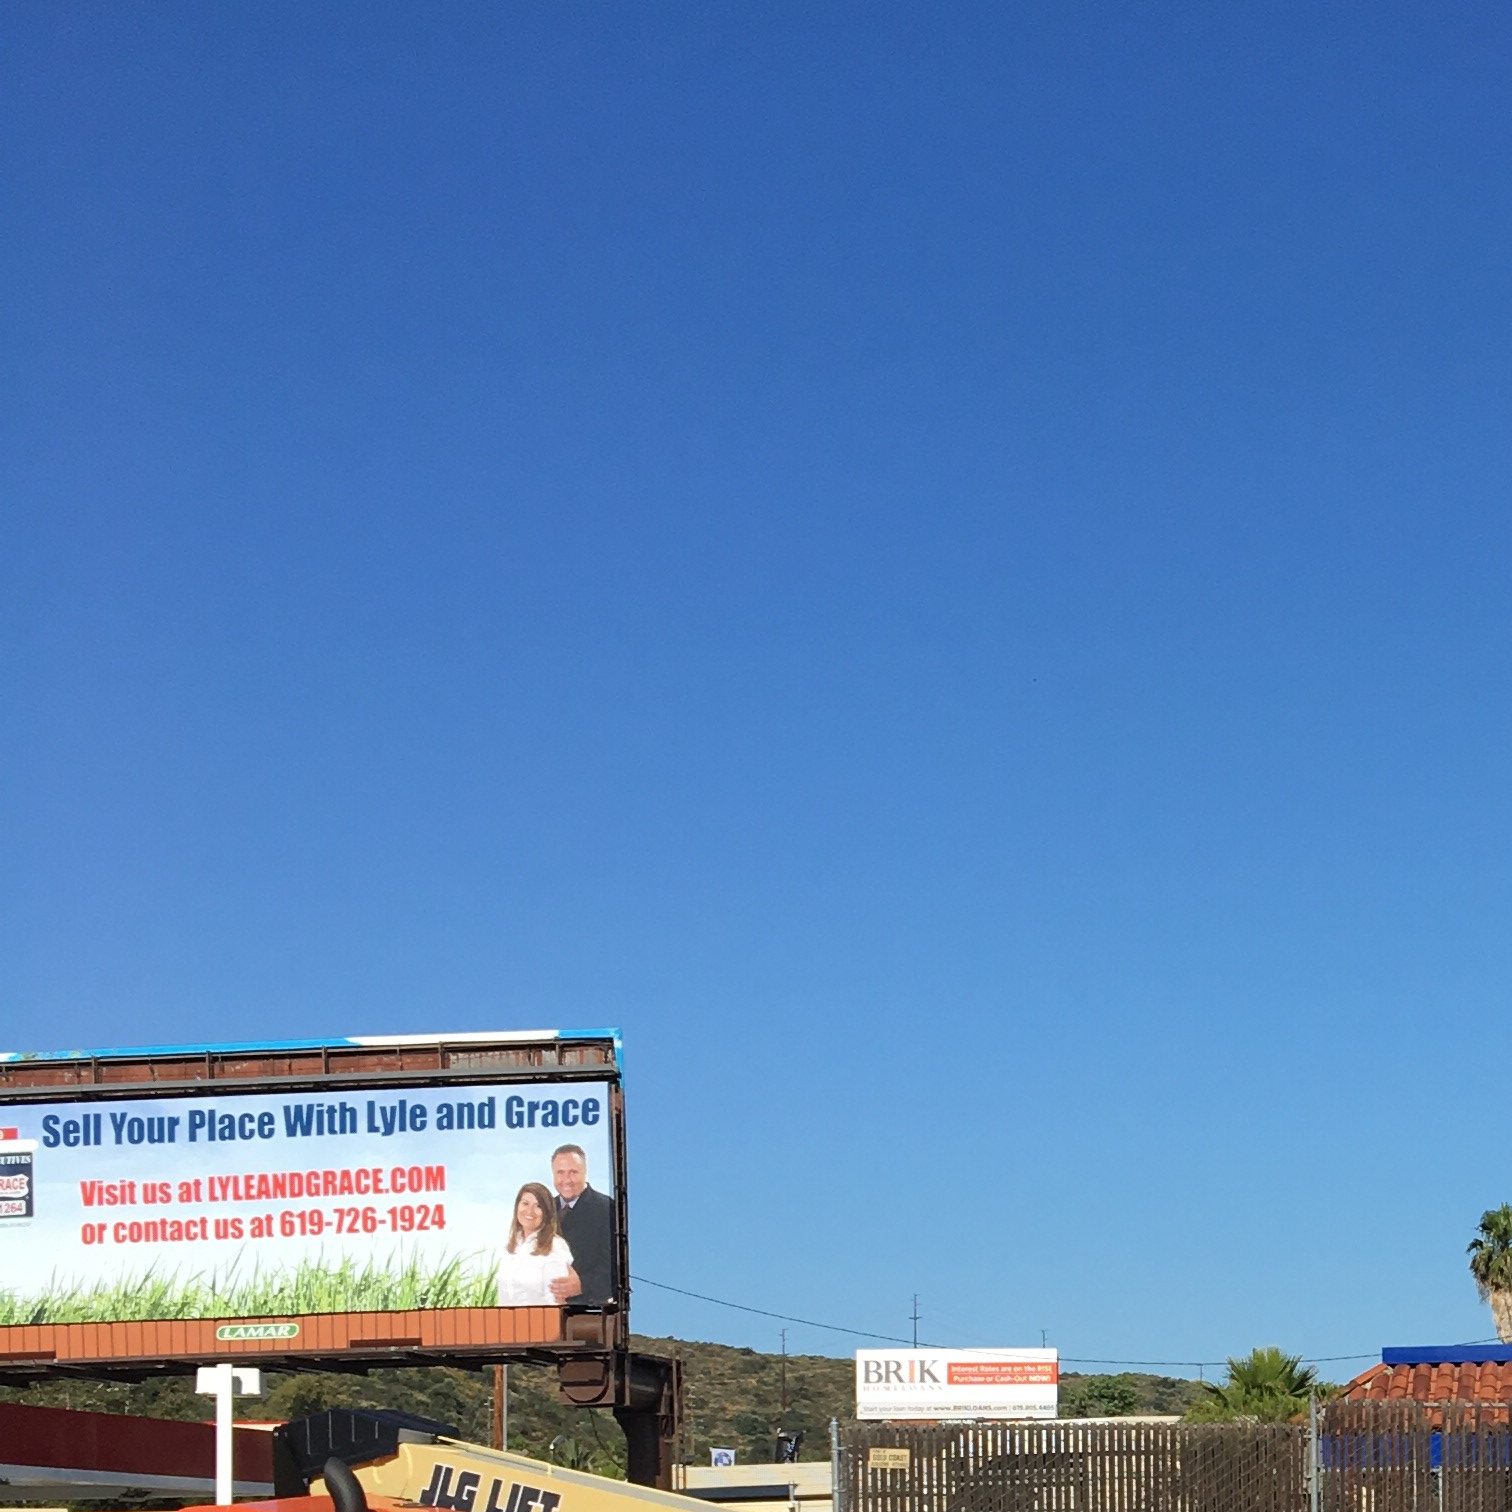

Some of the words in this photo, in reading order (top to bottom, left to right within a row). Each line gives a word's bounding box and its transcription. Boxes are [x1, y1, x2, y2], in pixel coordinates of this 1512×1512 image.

[42, 1113, 101, 1148] Sell
[110, 1111, 180, 1145] Your
[188, 1109, 275, 1142] Place
[283, 1102, 358, 1137] With
[366, 1099, 428, 1136] Lyle
[436, 1097, 496, 1131] and
[505, 1095, 600, 1129] Grace
[80, 1179, 137, 1206] Visit
[142, 1180, 172, 1205] us
[178, 1178, 202, 1204] at
[208, 1165, 446, 1201] LYLEANDGRACE.COM
[81, 1222, 108, 1245] or
[113, 1216, 208, 1244] contact
[215, 1216, 244, 1241] us
[250, 1213, 274, 1238] at
[280, 1204, 446, 1237] 619-726-1924
[223, 1325, 291, 1338] LAMAR
[864, 1360, 942, 1384] BRIK
[420, 1465, 481, 1512] JLG
